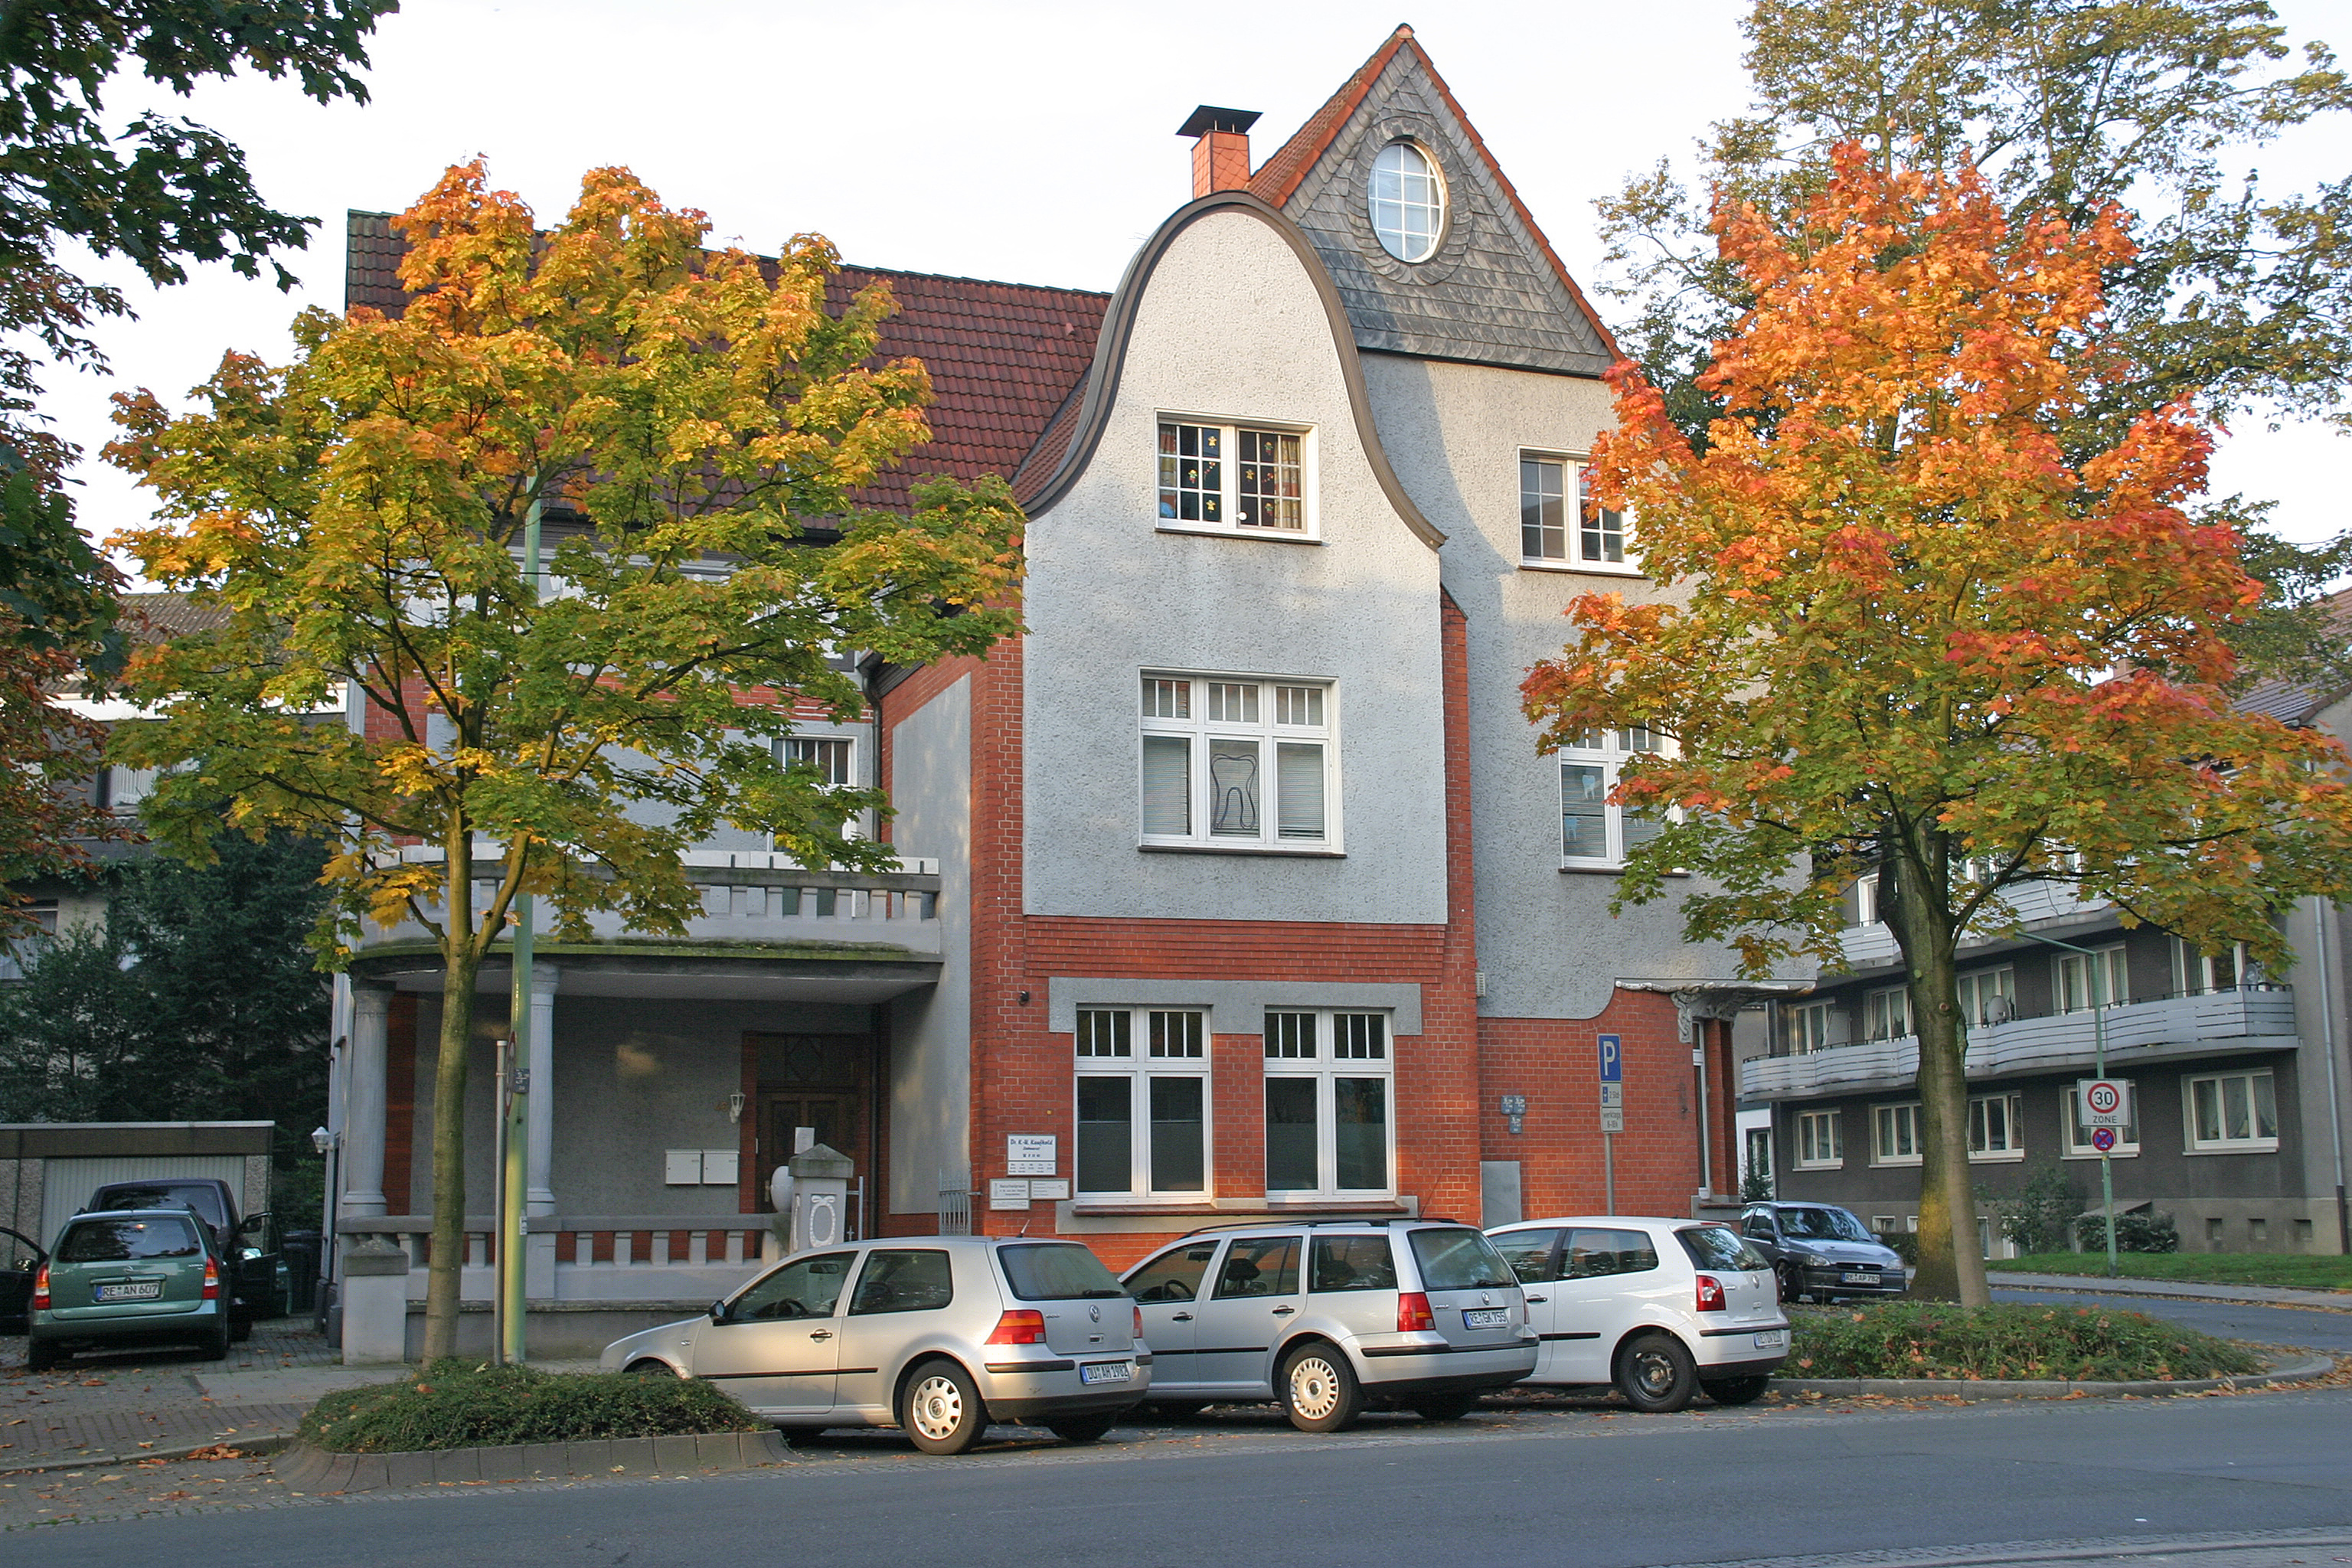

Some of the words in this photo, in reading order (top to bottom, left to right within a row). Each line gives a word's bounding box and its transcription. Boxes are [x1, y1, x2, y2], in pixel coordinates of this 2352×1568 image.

[1603, 1040, 1615, 1076] P
[2094, 1091, 2113, 1106] 30
[2092, 1116, 2118, 1124] ZONE
[103, 1286, 116, 1296] RE
[123, 1285, 137, 1295] AN
[139, 1284, 158, 1294] 607
[1468, 1312, 1481, 1324] RE
[1086, 1367, 1098, 1379] DU
